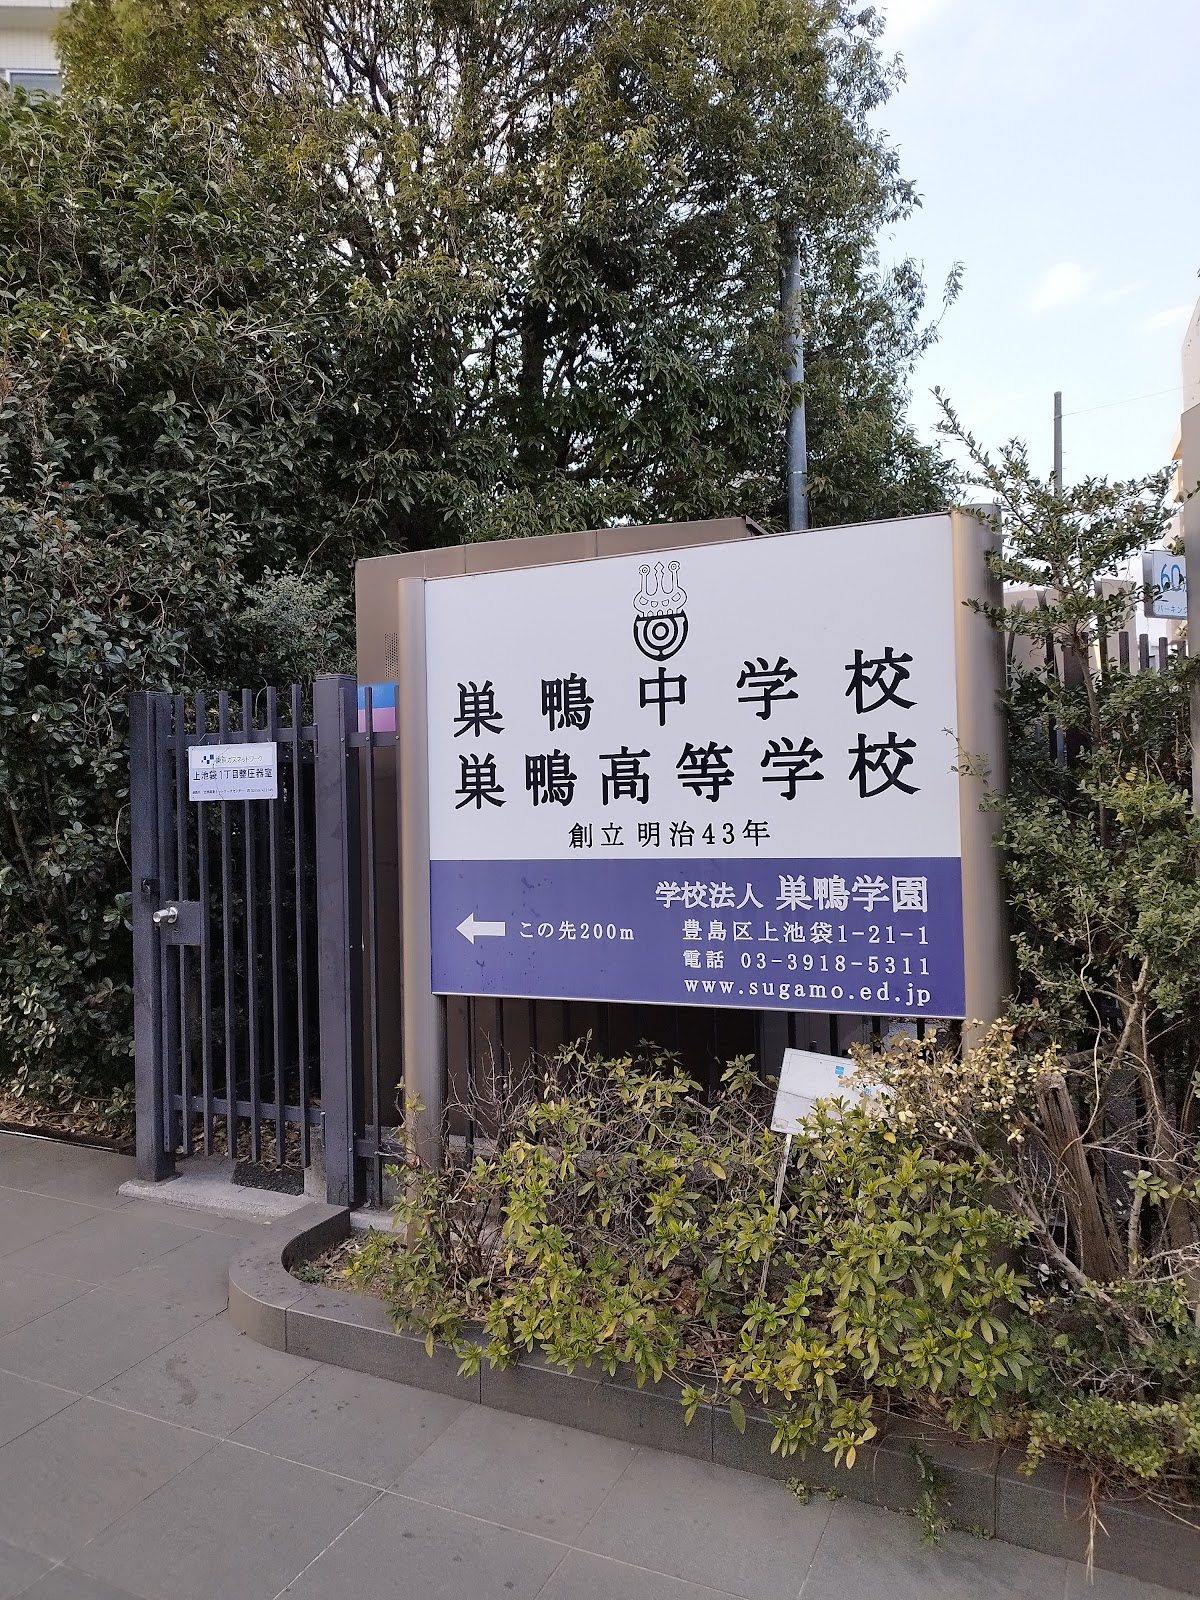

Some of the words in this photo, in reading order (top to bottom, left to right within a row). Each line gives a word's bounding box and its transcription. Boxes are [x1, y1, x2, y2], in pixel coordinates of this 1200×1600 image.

[453, 646, 918, 738] 巣鴨中学校
[454, 731, 921, 810] 巣鴨高等学校
[655, 881, 764, 909] 学校法人
[776, 874, 928, 913] 巣鴨学園
[519, 920, 635, 941] この先200m
[683, 950, 725, 970] 電話
[740, 952, 930, 975] 03-3918-5311
[684, 978, 931, 1007] www.sugamo.ed.jp
